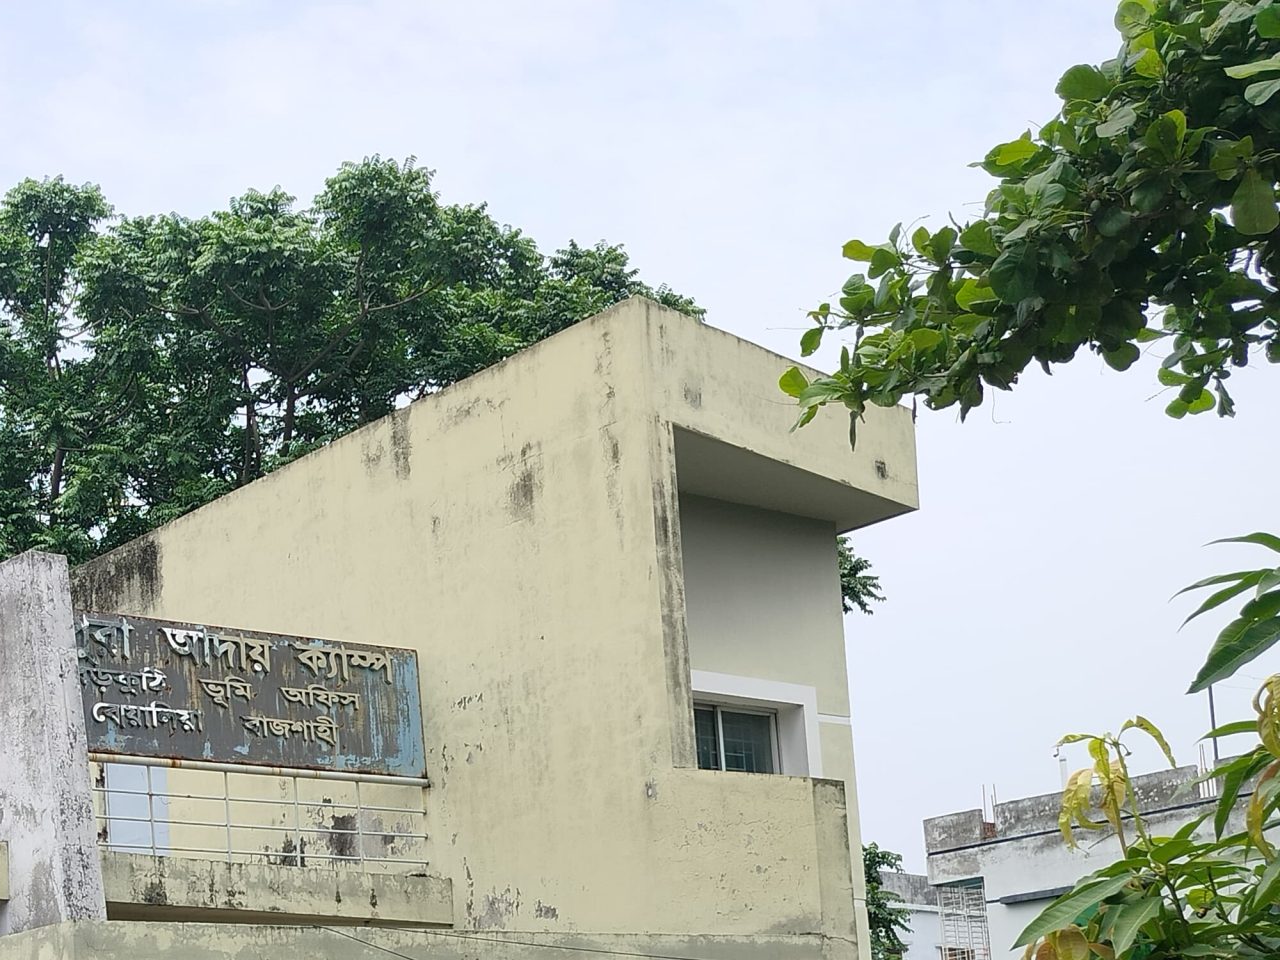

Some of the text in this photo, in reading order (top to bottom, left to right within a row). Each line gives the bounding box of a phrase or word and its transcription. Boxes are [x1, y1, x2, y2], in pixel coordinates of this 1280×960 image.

[159, 625, 272, 675] আদায়
[291, 642, 394, 685] ক্যাম্প
[199, 675, 253, 708] ভূমি
[279, 683, 360, 711] অফিস
[92, 700, 204, 732] বোয়ালিয়া
